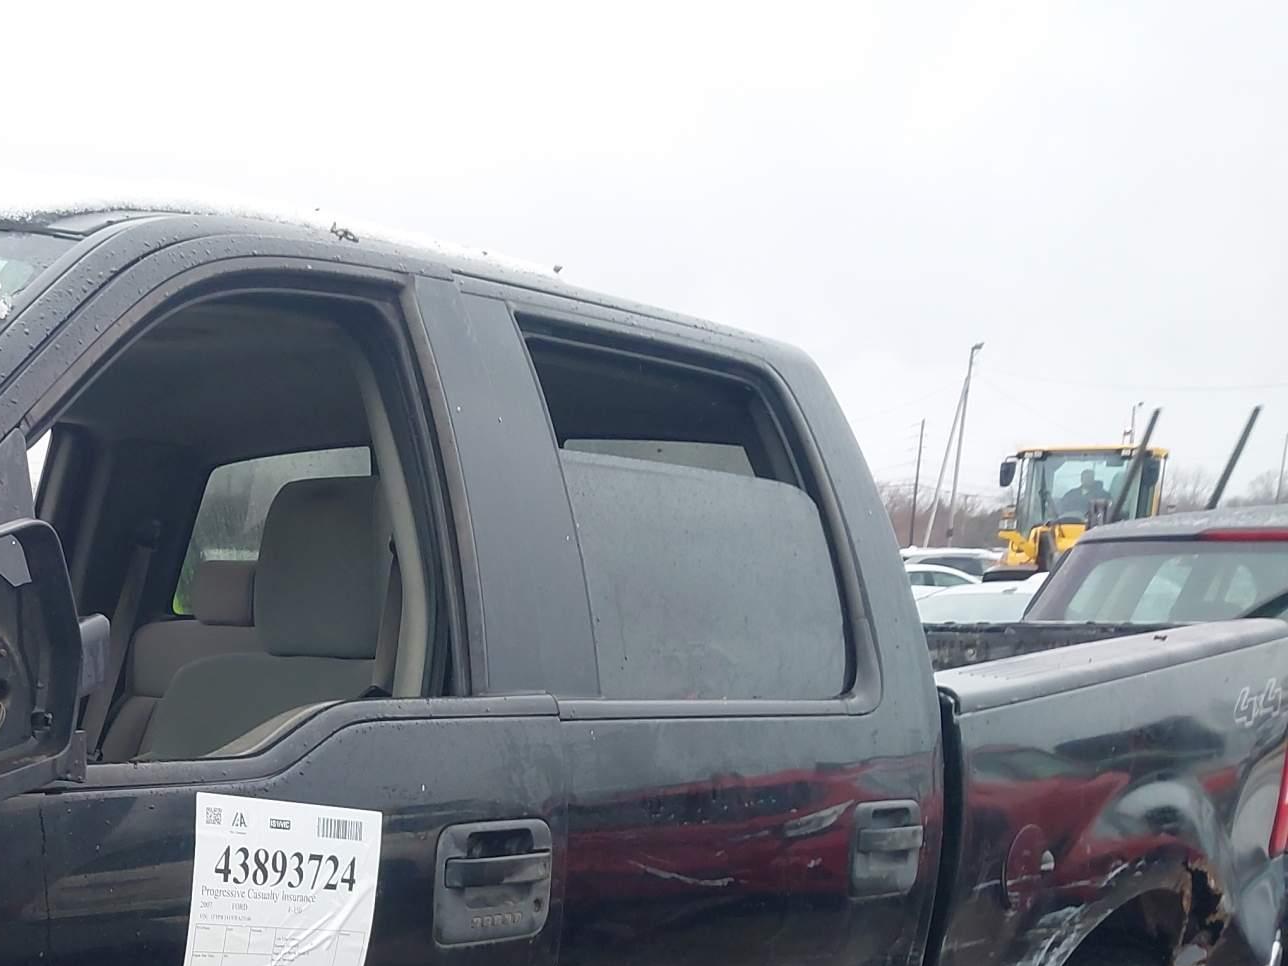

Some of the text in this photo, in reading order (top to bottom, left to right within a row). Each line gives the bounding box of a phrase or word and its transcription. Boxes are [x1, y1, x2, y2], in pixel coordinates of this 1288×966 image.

[214, 845, 357, 892] 43893724
[201, 885, 317, 904] Progressive Casualty Insurance
